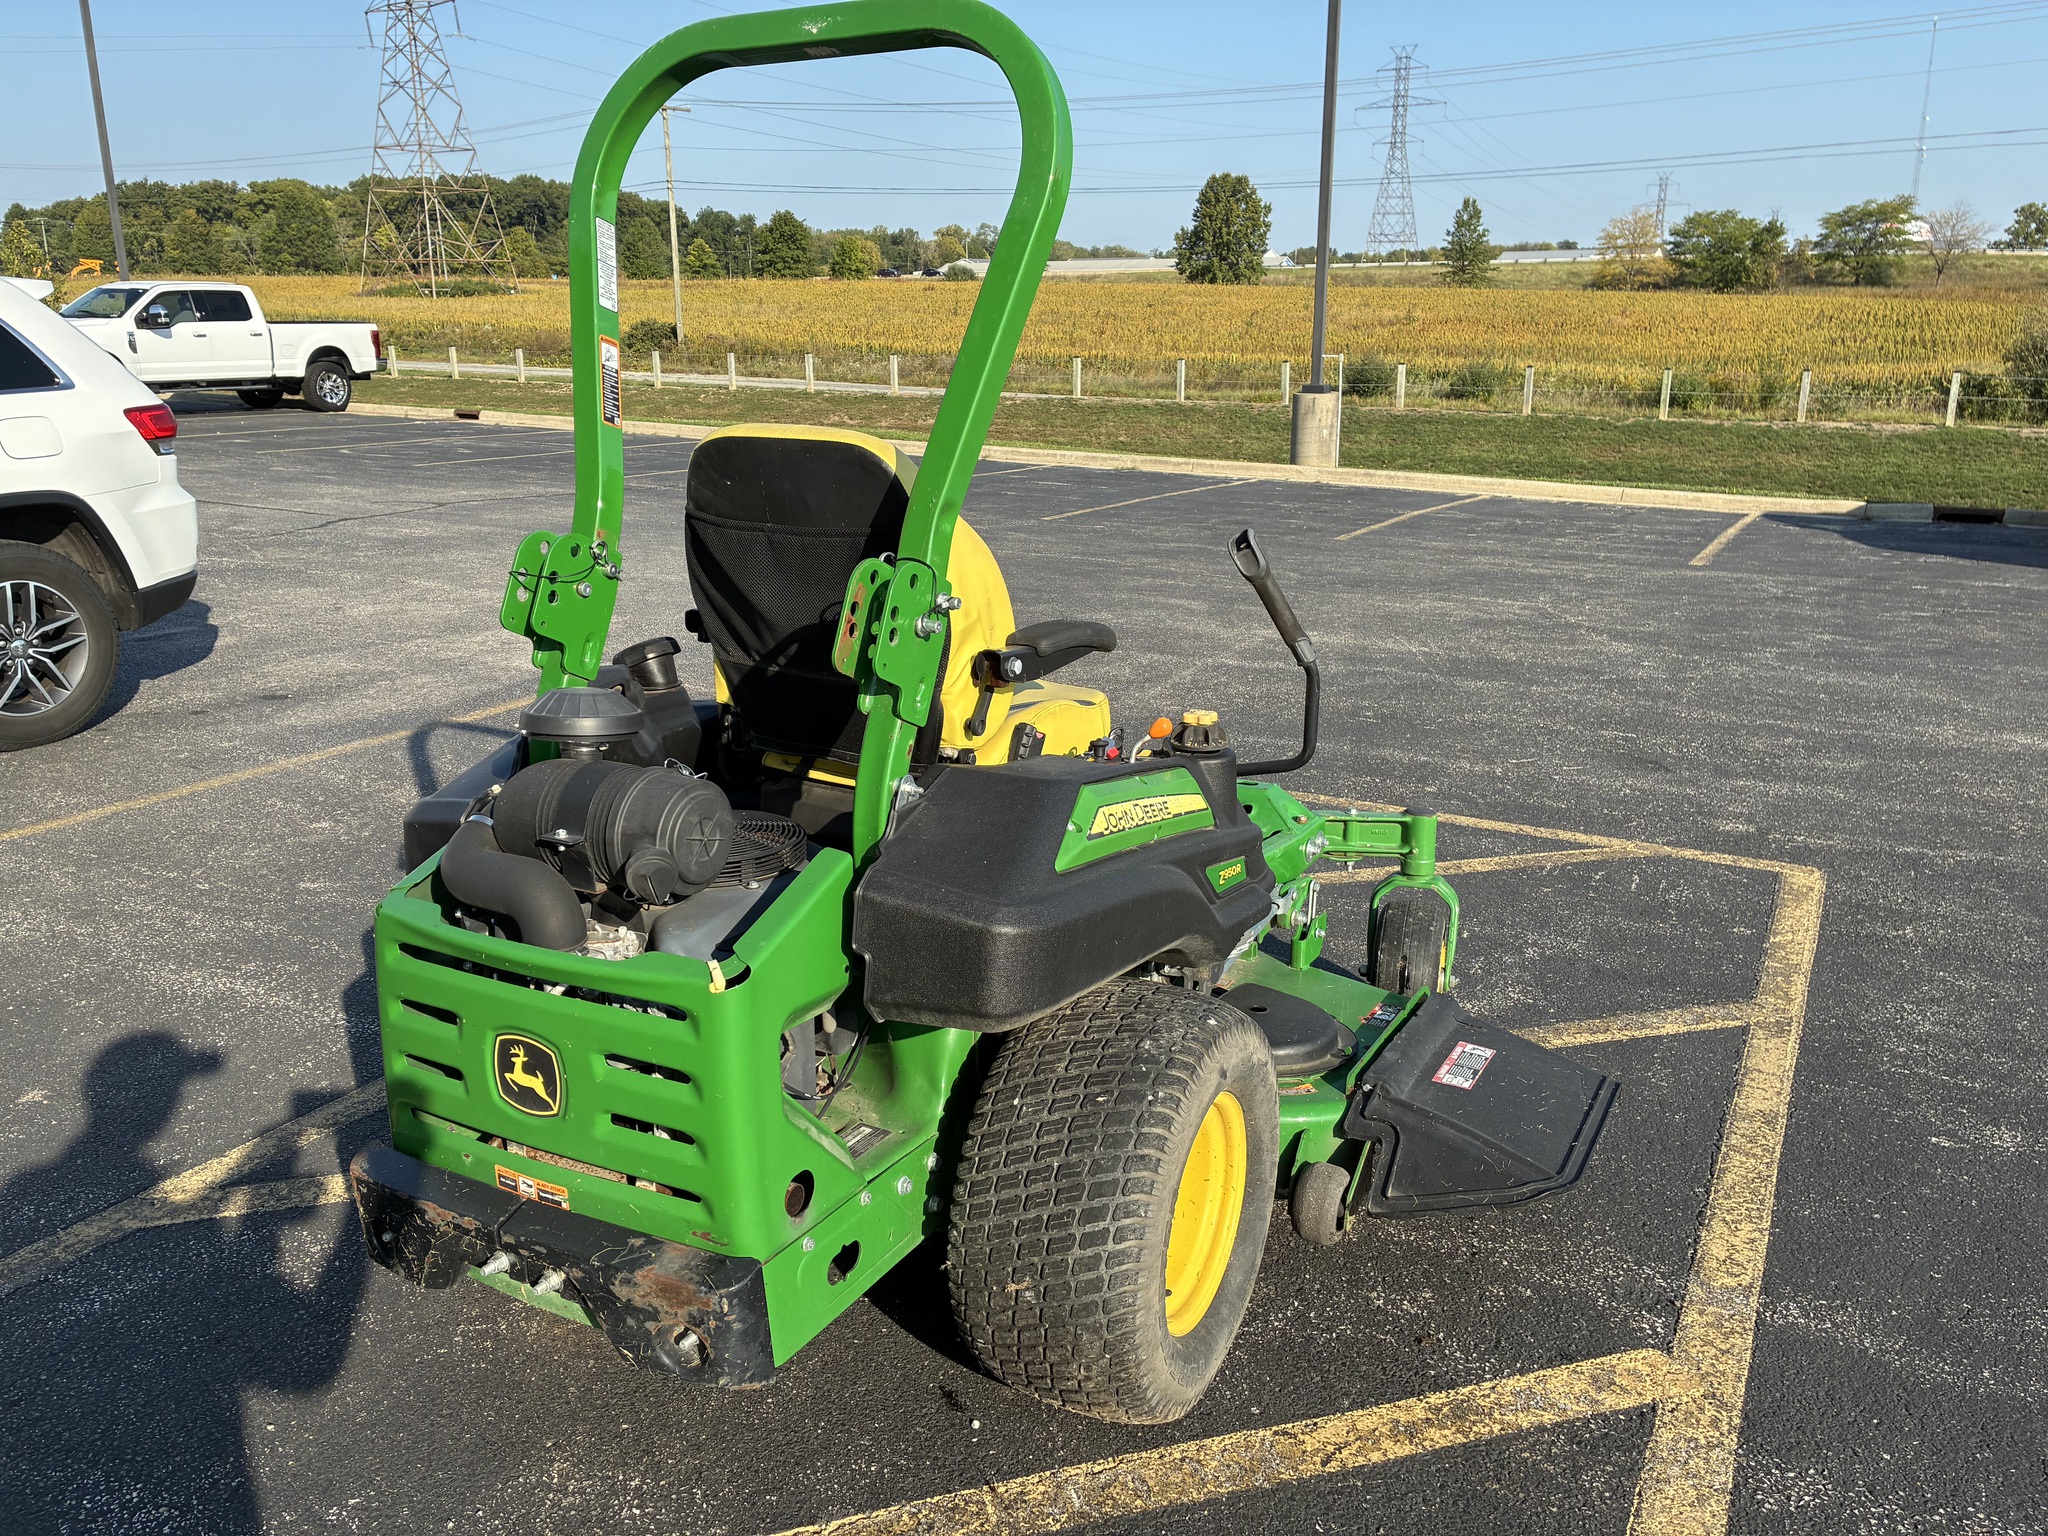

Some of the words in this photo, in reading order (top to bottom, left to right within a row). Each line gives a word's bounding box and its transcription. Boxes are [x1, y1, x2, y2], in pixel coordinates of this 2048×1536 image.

[1103, 809, 1134, 832] JOHN
[1133, 800, 1172, 821] DEERE
[1218, 864, 1241, 885] Z950R
